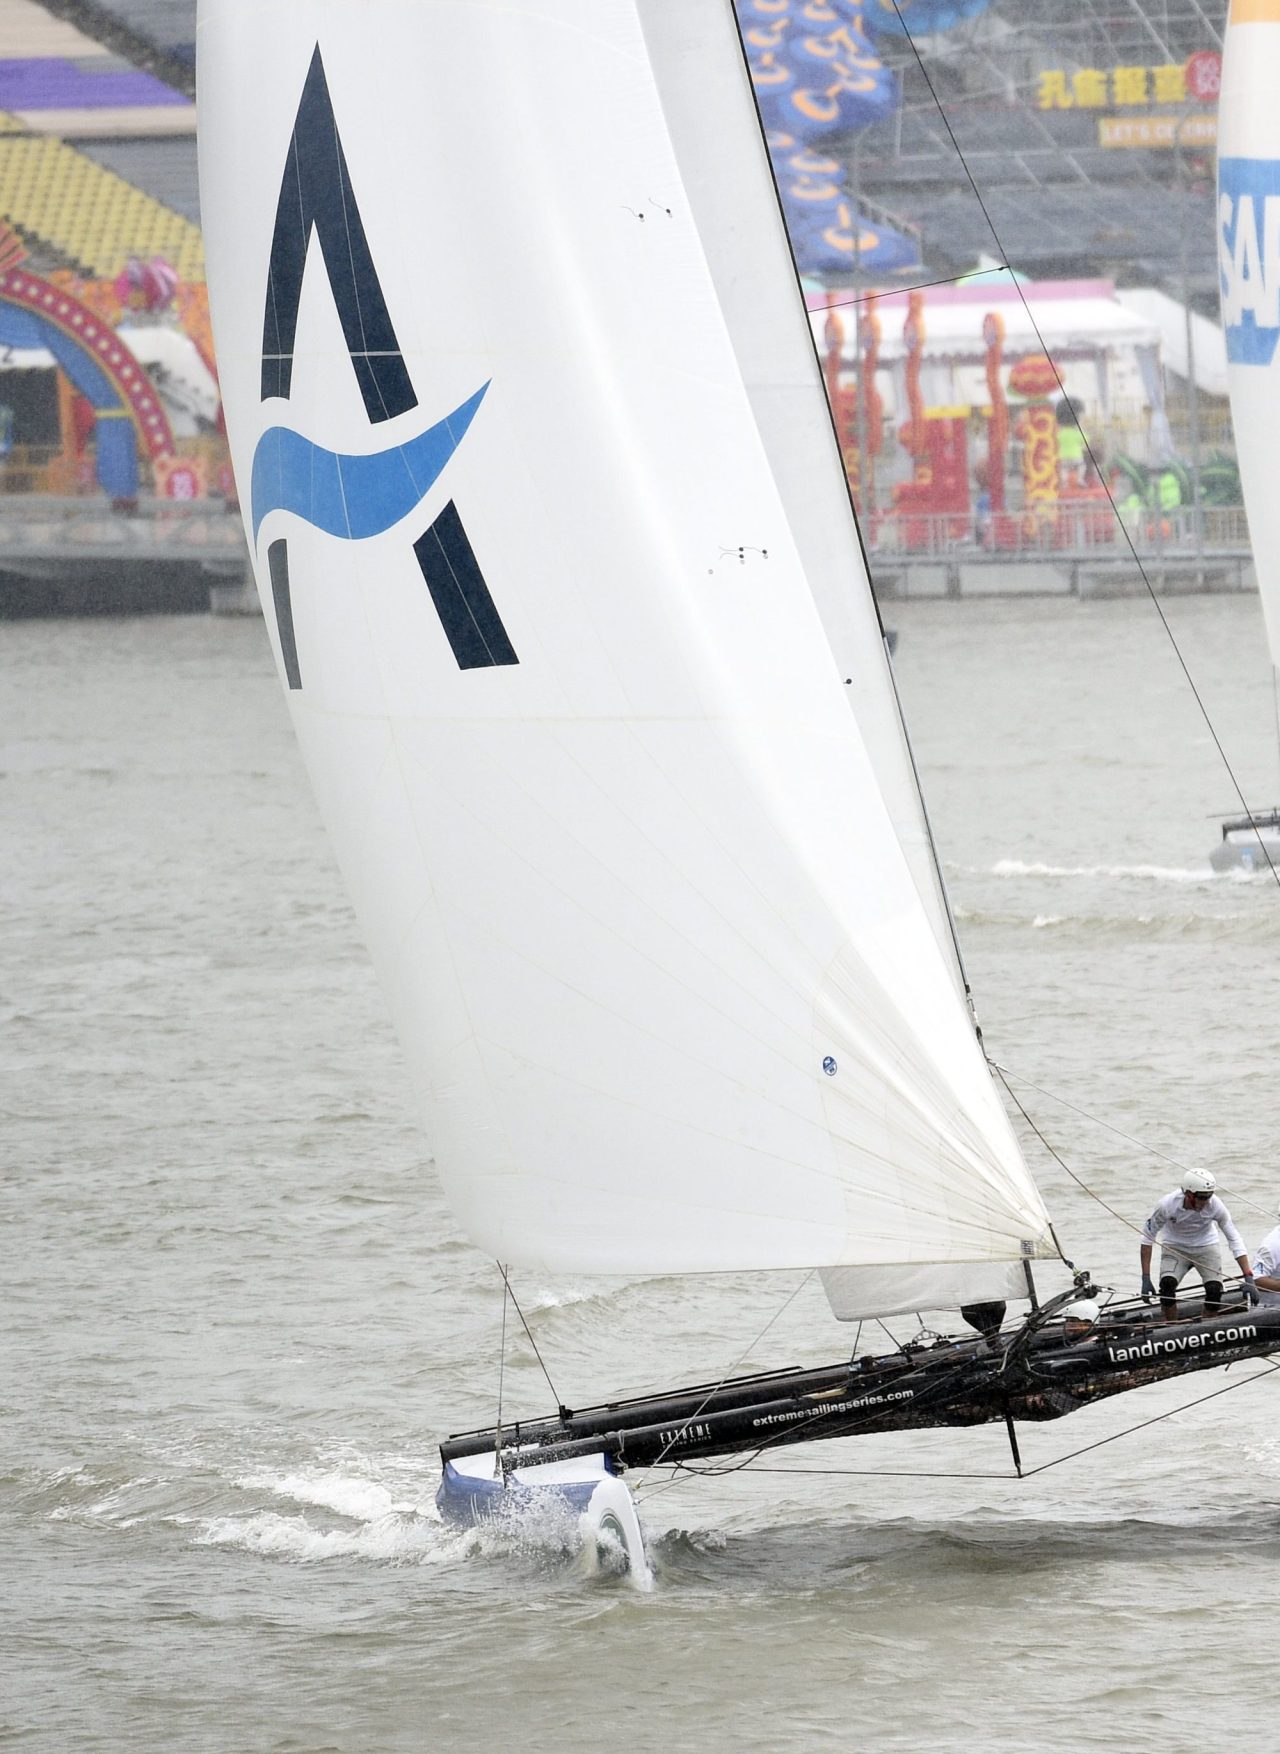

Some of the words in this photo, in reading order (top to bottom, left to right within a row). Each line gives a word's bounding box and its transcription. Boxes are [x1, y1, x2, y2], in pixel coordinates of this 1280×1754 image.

[1109, 1325, 1258, 1363] landrover.com
[752, 1389, 914, 1428] extremesailingseries.com
[659, 1423, 711, 1444] EXTREME
